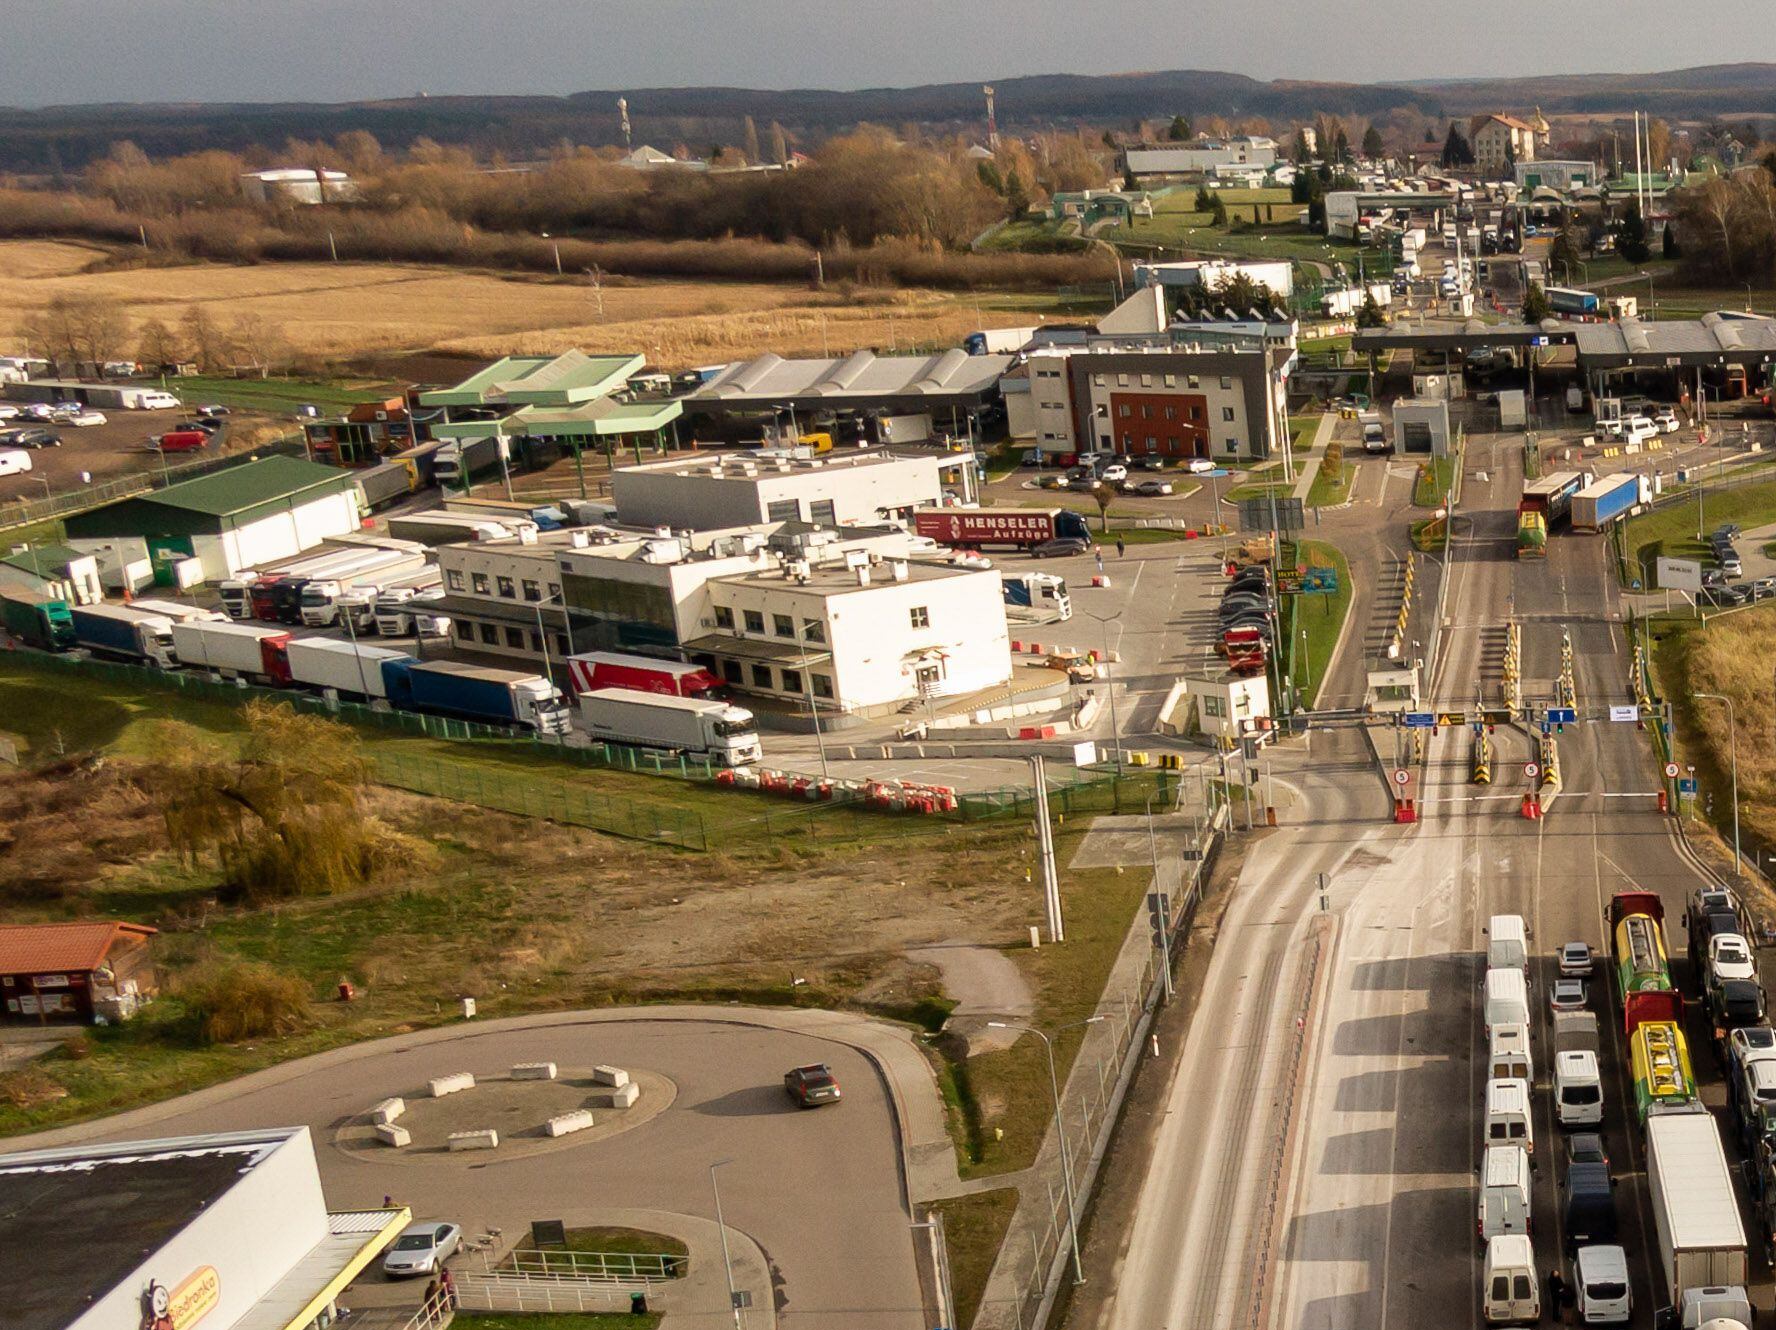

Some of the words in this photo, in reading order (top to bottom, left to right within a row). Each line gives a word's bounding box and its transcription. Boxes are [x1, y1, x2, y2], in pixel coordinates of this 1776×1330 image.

[964, 517, 1049, 529] HENSELER
[993, 529, 1049, 540] Aufzüge
[1529, 766, 1535, 774] 5
[1669, 766, 1675, 774] 5
[1399, 773, 1405, 781] 5
